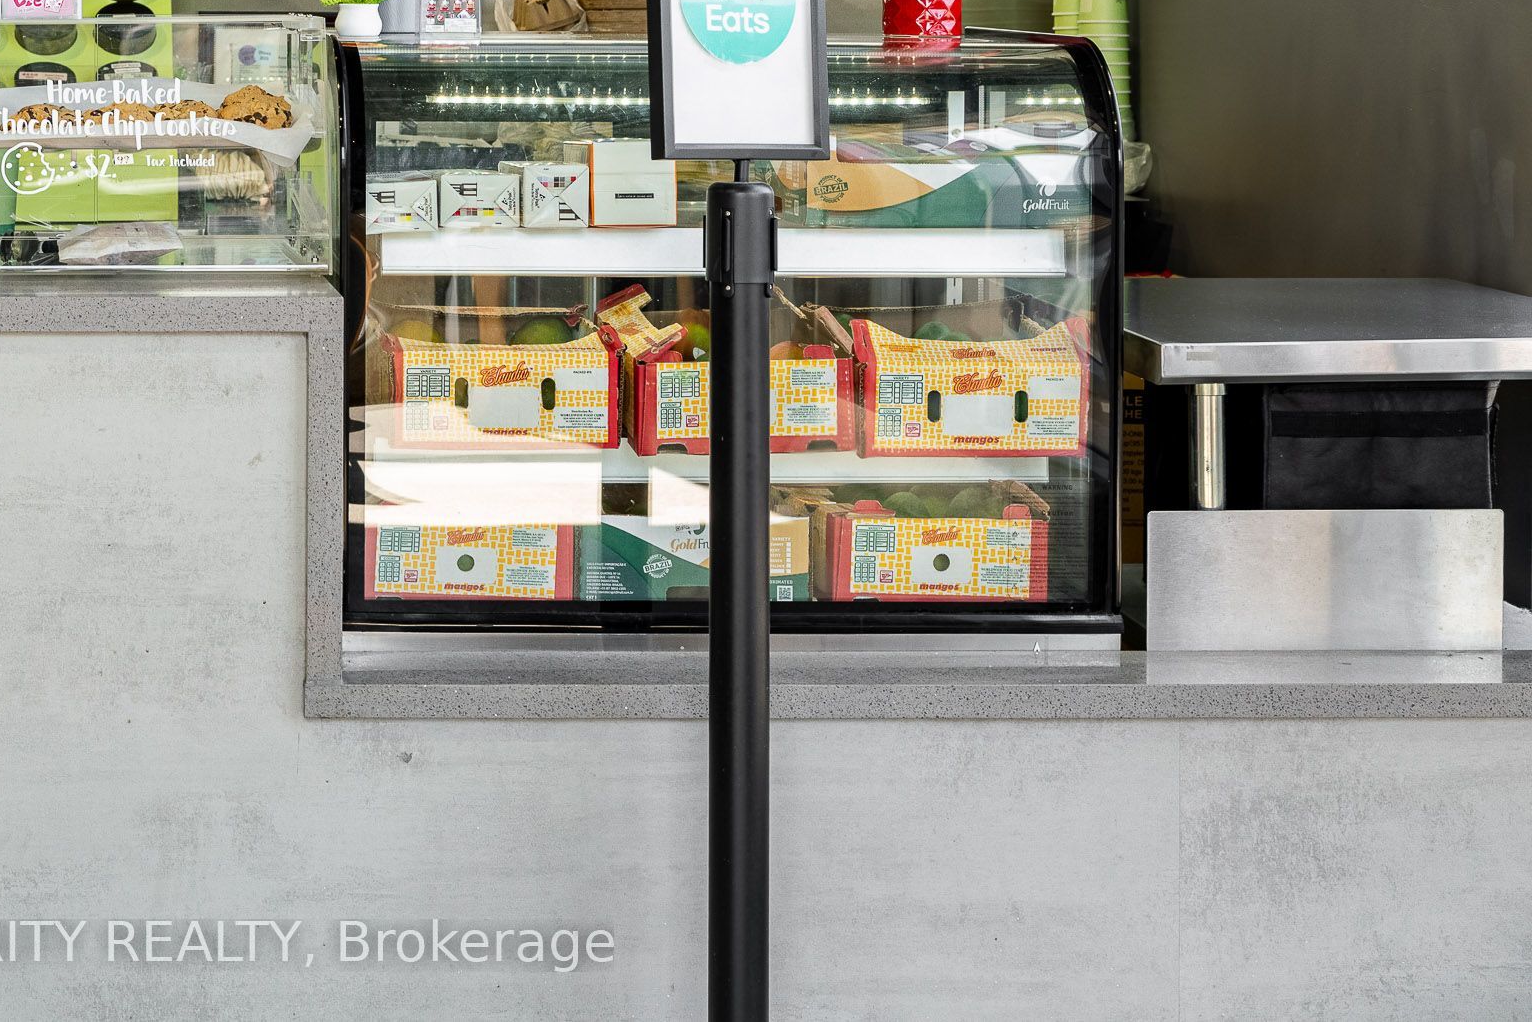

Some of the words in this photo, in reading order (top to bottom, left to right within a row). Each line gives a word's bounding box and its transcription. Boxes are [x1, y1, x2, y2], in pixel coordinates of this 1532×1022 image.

[706, 4, 770, 34] Eats
[46, 77, 181, 105] Home-Baked
[101, 109, 150, 150] Chip
[154, 111, 237, 138] Cookies
[146, 155, 167, 168] Tax
[170, 155, 215, 168] Included
[814, 182, 848, 196] BRAZIL
[1023, 198, 1070, 214] GoldFruit
[954, 436, 1000, 446] mangos
[670, 538, 709, 553] GoldFr
[643, 560, 672, 572] BRAZIL
[444, 583, 485, 592] mangos
[919, 583, 960, 592] mangos
